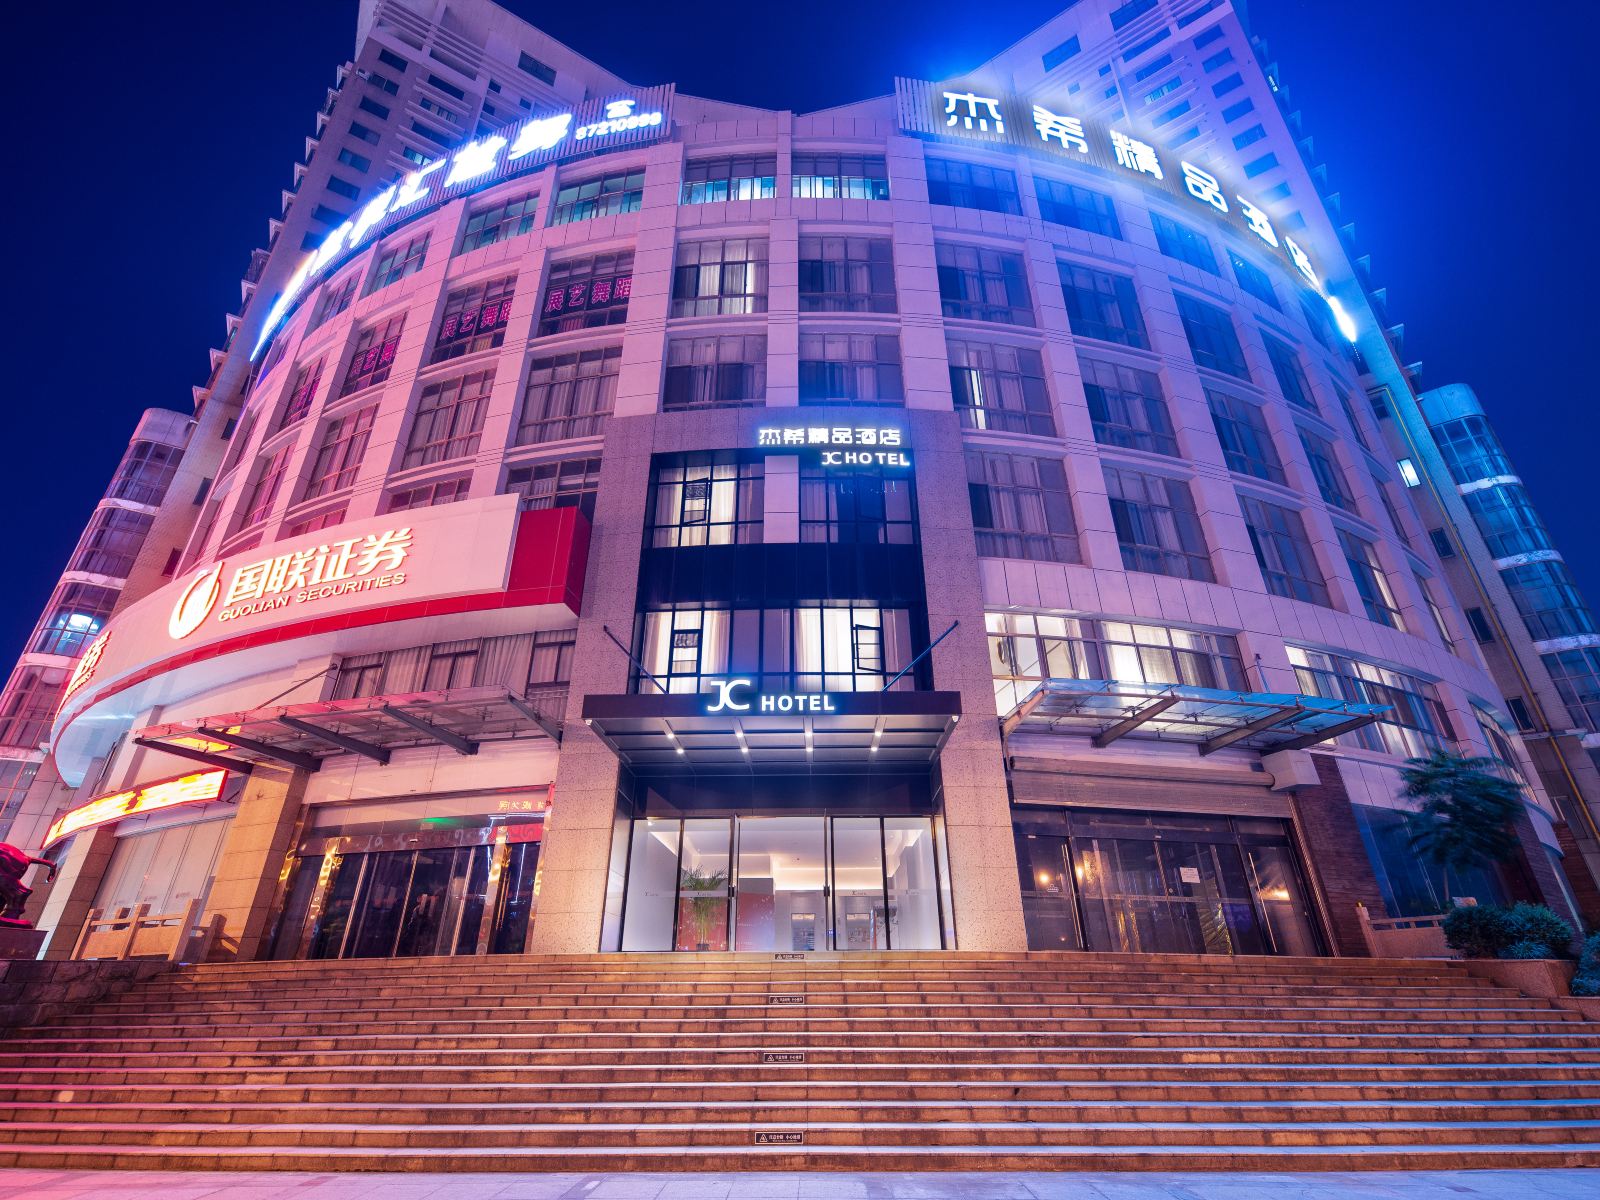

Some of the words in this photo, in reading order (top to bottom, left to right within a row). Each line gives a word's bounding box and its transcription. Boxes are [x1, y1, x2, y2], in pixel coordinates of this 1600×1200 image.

[942, 91, 1320, 287] 杰希精品酒店
[545, 277, 632, 313] 展艺舞蹈
[759, 428, 901, 446] 杰希精品酒店
[845, 452, 910, 466] HOTEL
[223, 527, 414, 607] 国联证券
[217, 595, 290, 623] GUOLIAN
[295, 572, 407, 604] SECURITIES
[707, 679, 751, 712] JC
[761, 695, 835, 711] HOTEL
